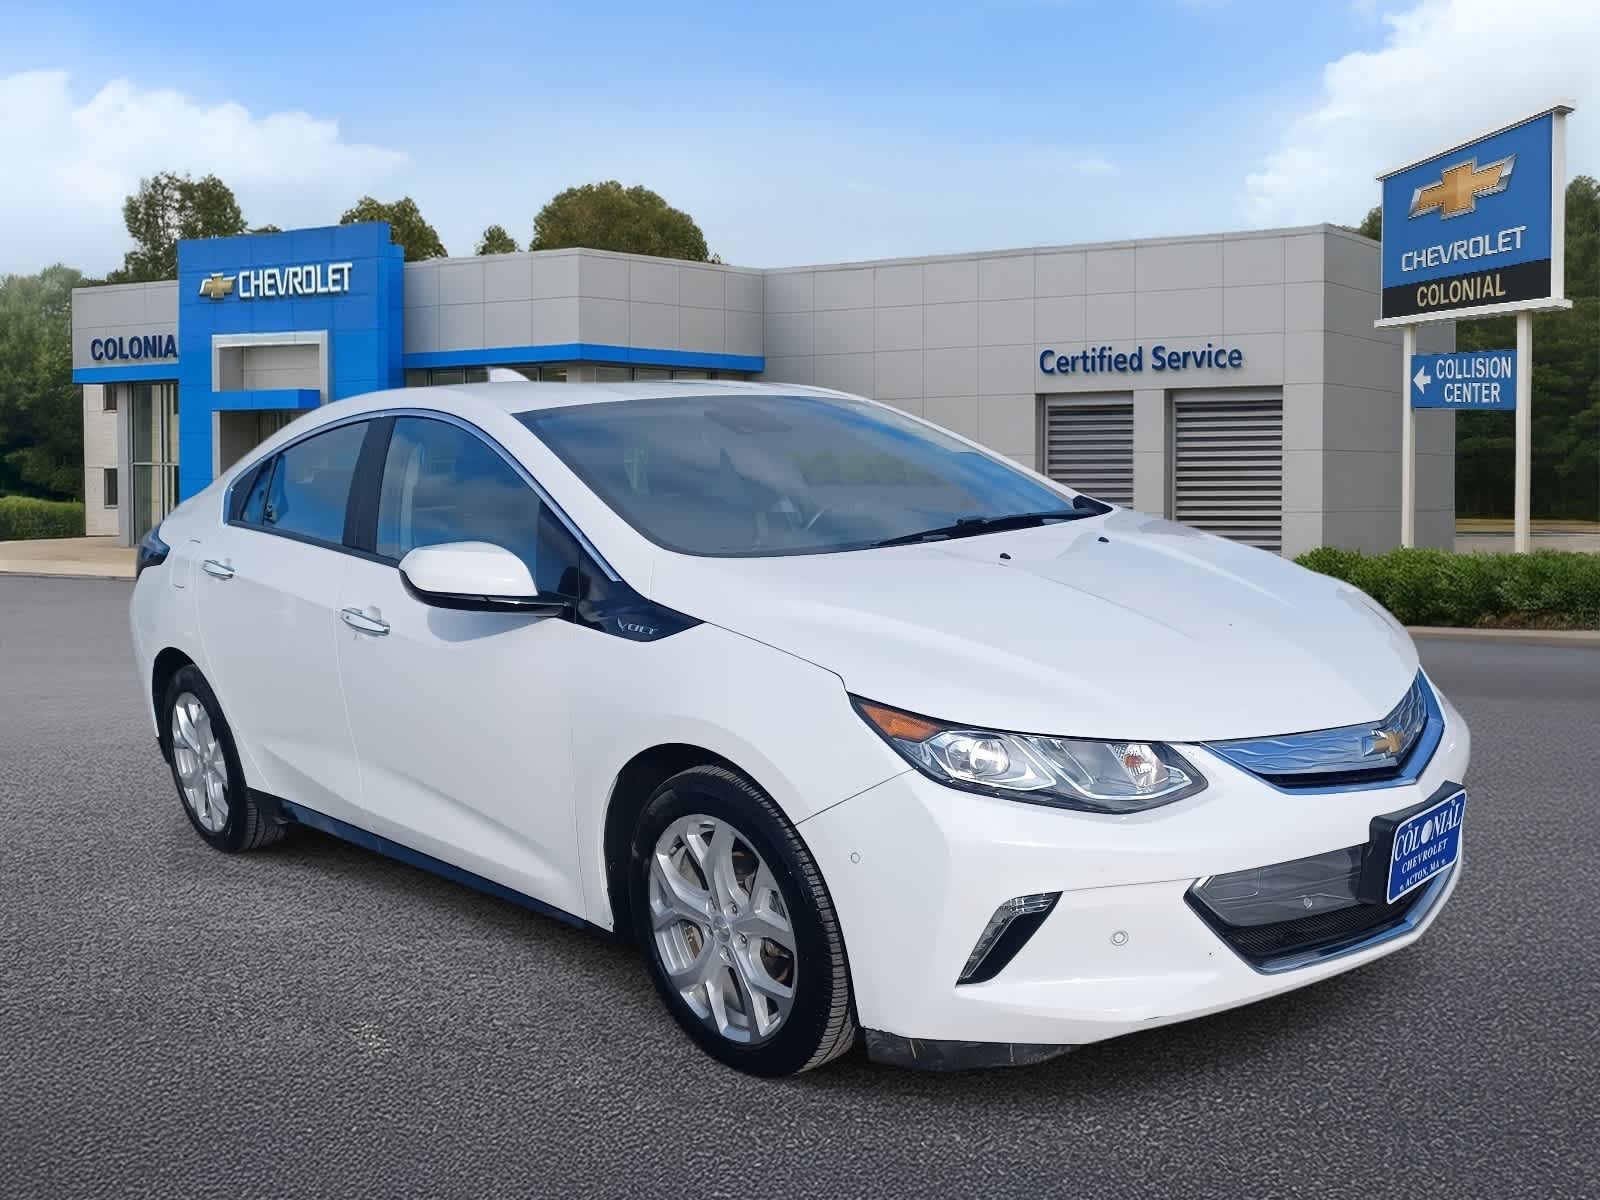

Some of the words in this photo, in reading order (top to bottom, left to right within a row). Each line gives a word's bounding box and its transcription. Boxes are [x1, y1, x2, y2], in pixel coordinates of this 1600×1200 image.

[1401, 226, 1527, 272] CHEVROLET
[238, 262, 353, 298] CHEVROLET
[1416, 273, 1506, 307] COLONIAL
[90, 334, 179, 361] COLONIA
[1039, 346, 1143, 374] Certified
[1151, 343, 1243, 371] Service
[1436, 357, 1512, 379] COLLISION
[1444, 382, 1501, 403] CENTER
[1396, 804, 1461, 861] COLONIAL
[1402, 840, 1447, 874] CHEVROLET
